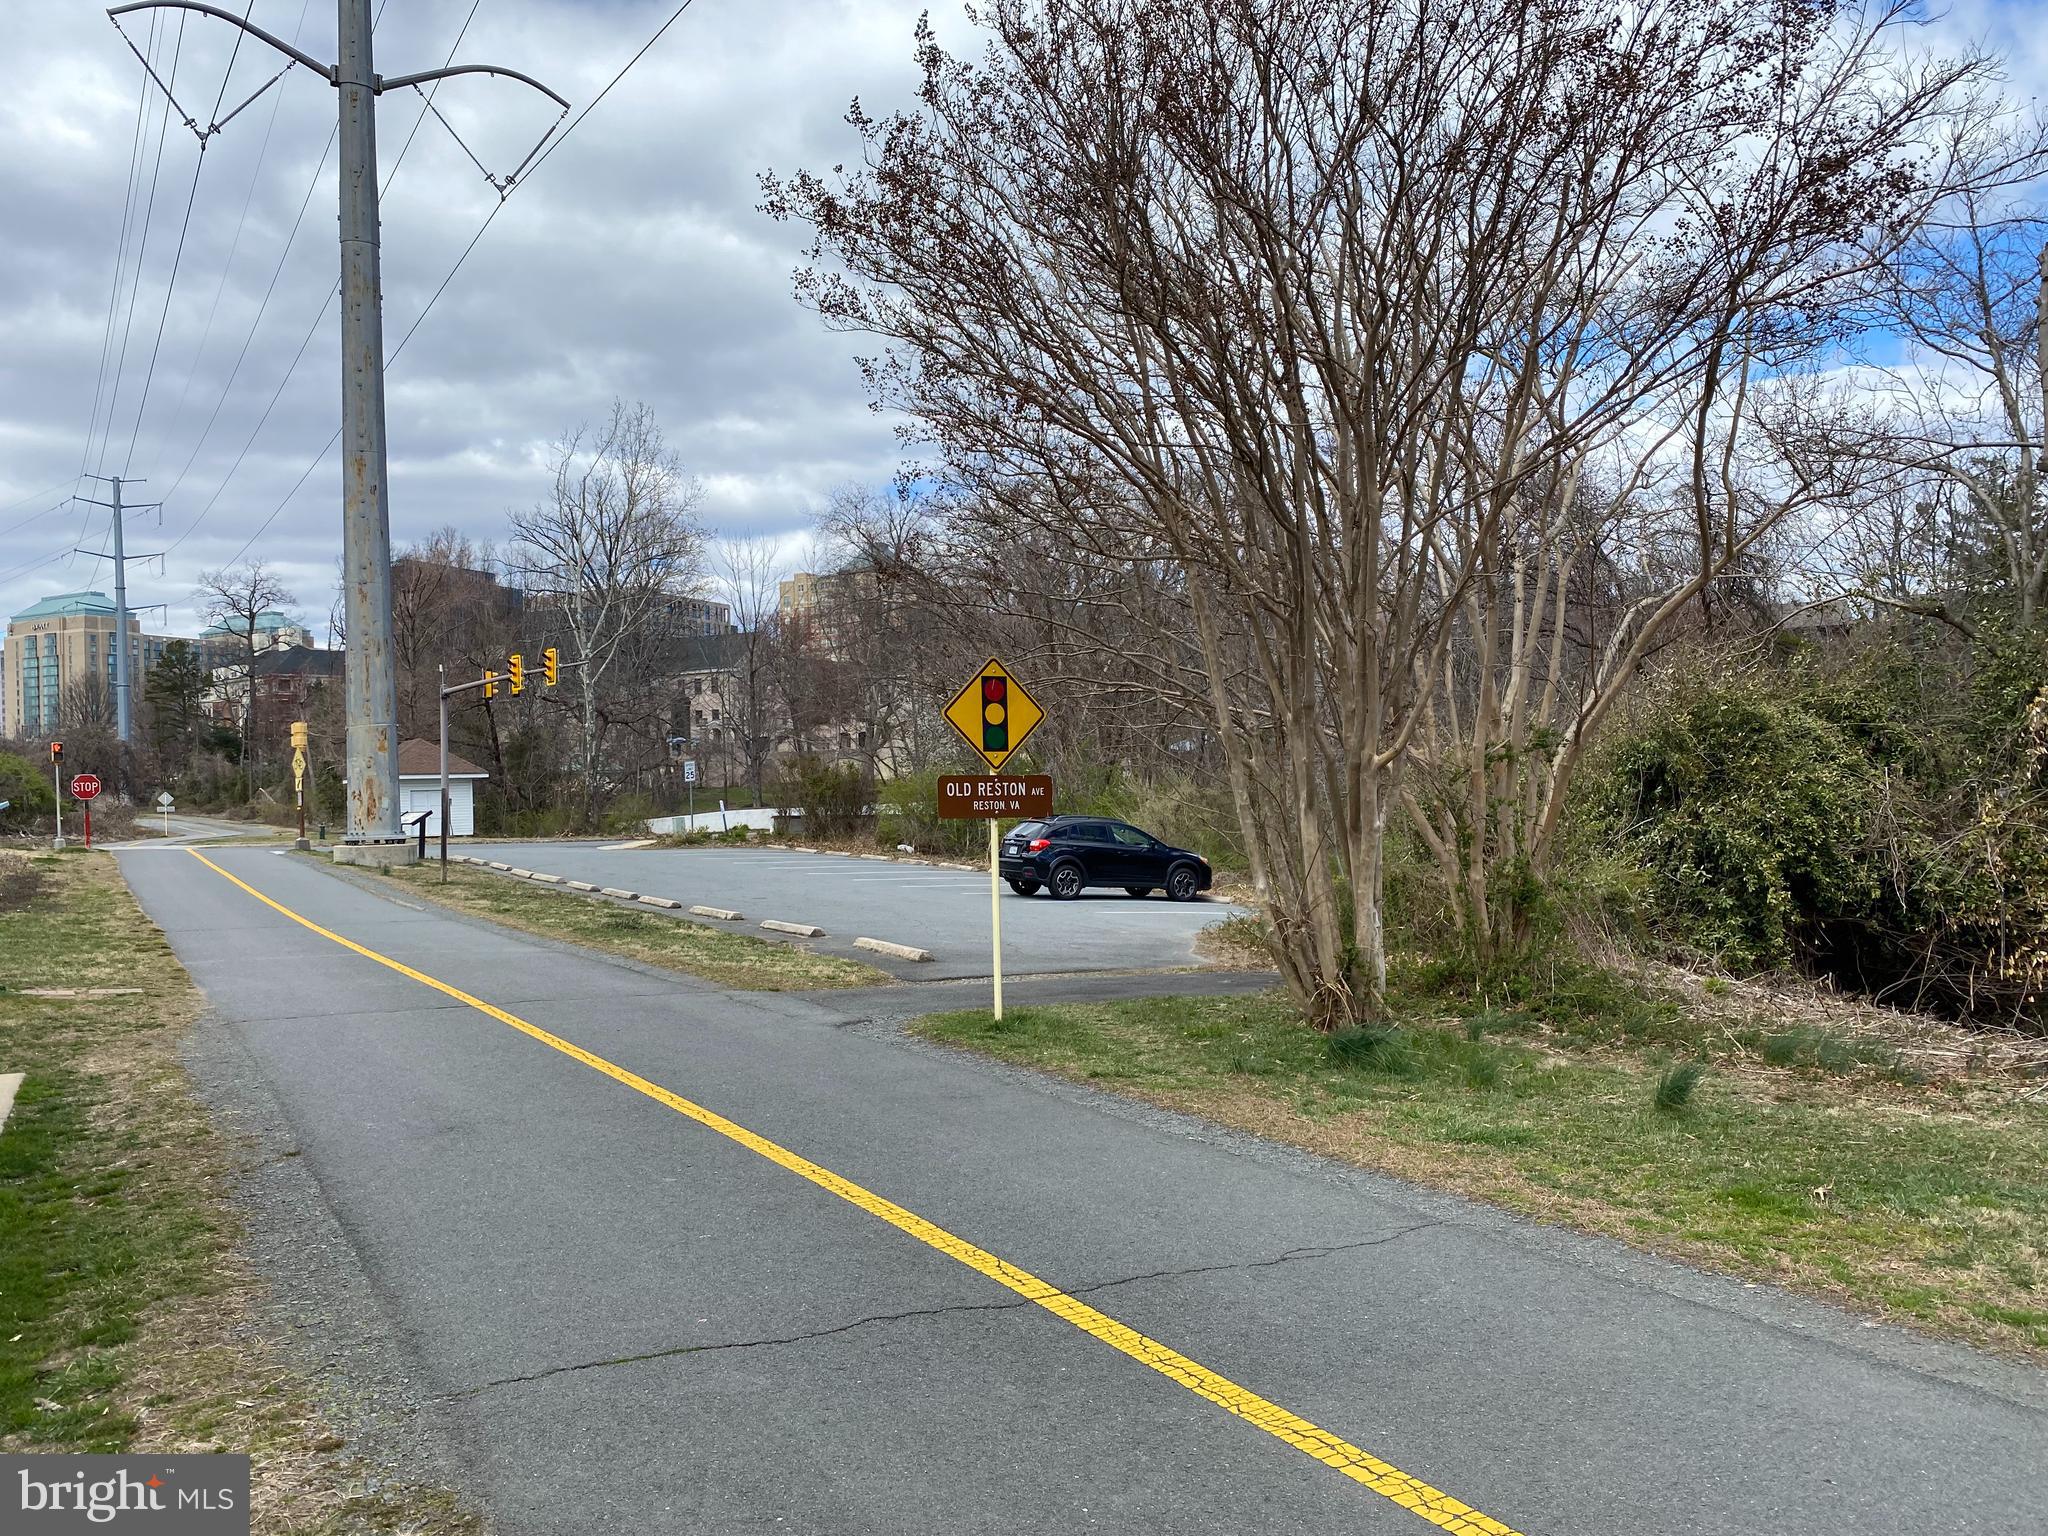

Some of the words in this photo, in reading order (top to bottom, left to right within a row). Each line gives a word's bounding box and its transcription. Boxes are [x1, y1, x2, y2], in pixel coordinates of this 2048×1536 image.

[685, 771, 695, 779] 25
[73, 782, 98, 792] STOP
[946, 782, 972, 797] OLD
[978, 782, 1026, 796] RESTON
[1031, 787, 1045, 796] AVE
[973, 800, 1005, 810] RESTON
[1009, 800, 1020, 810] VA
